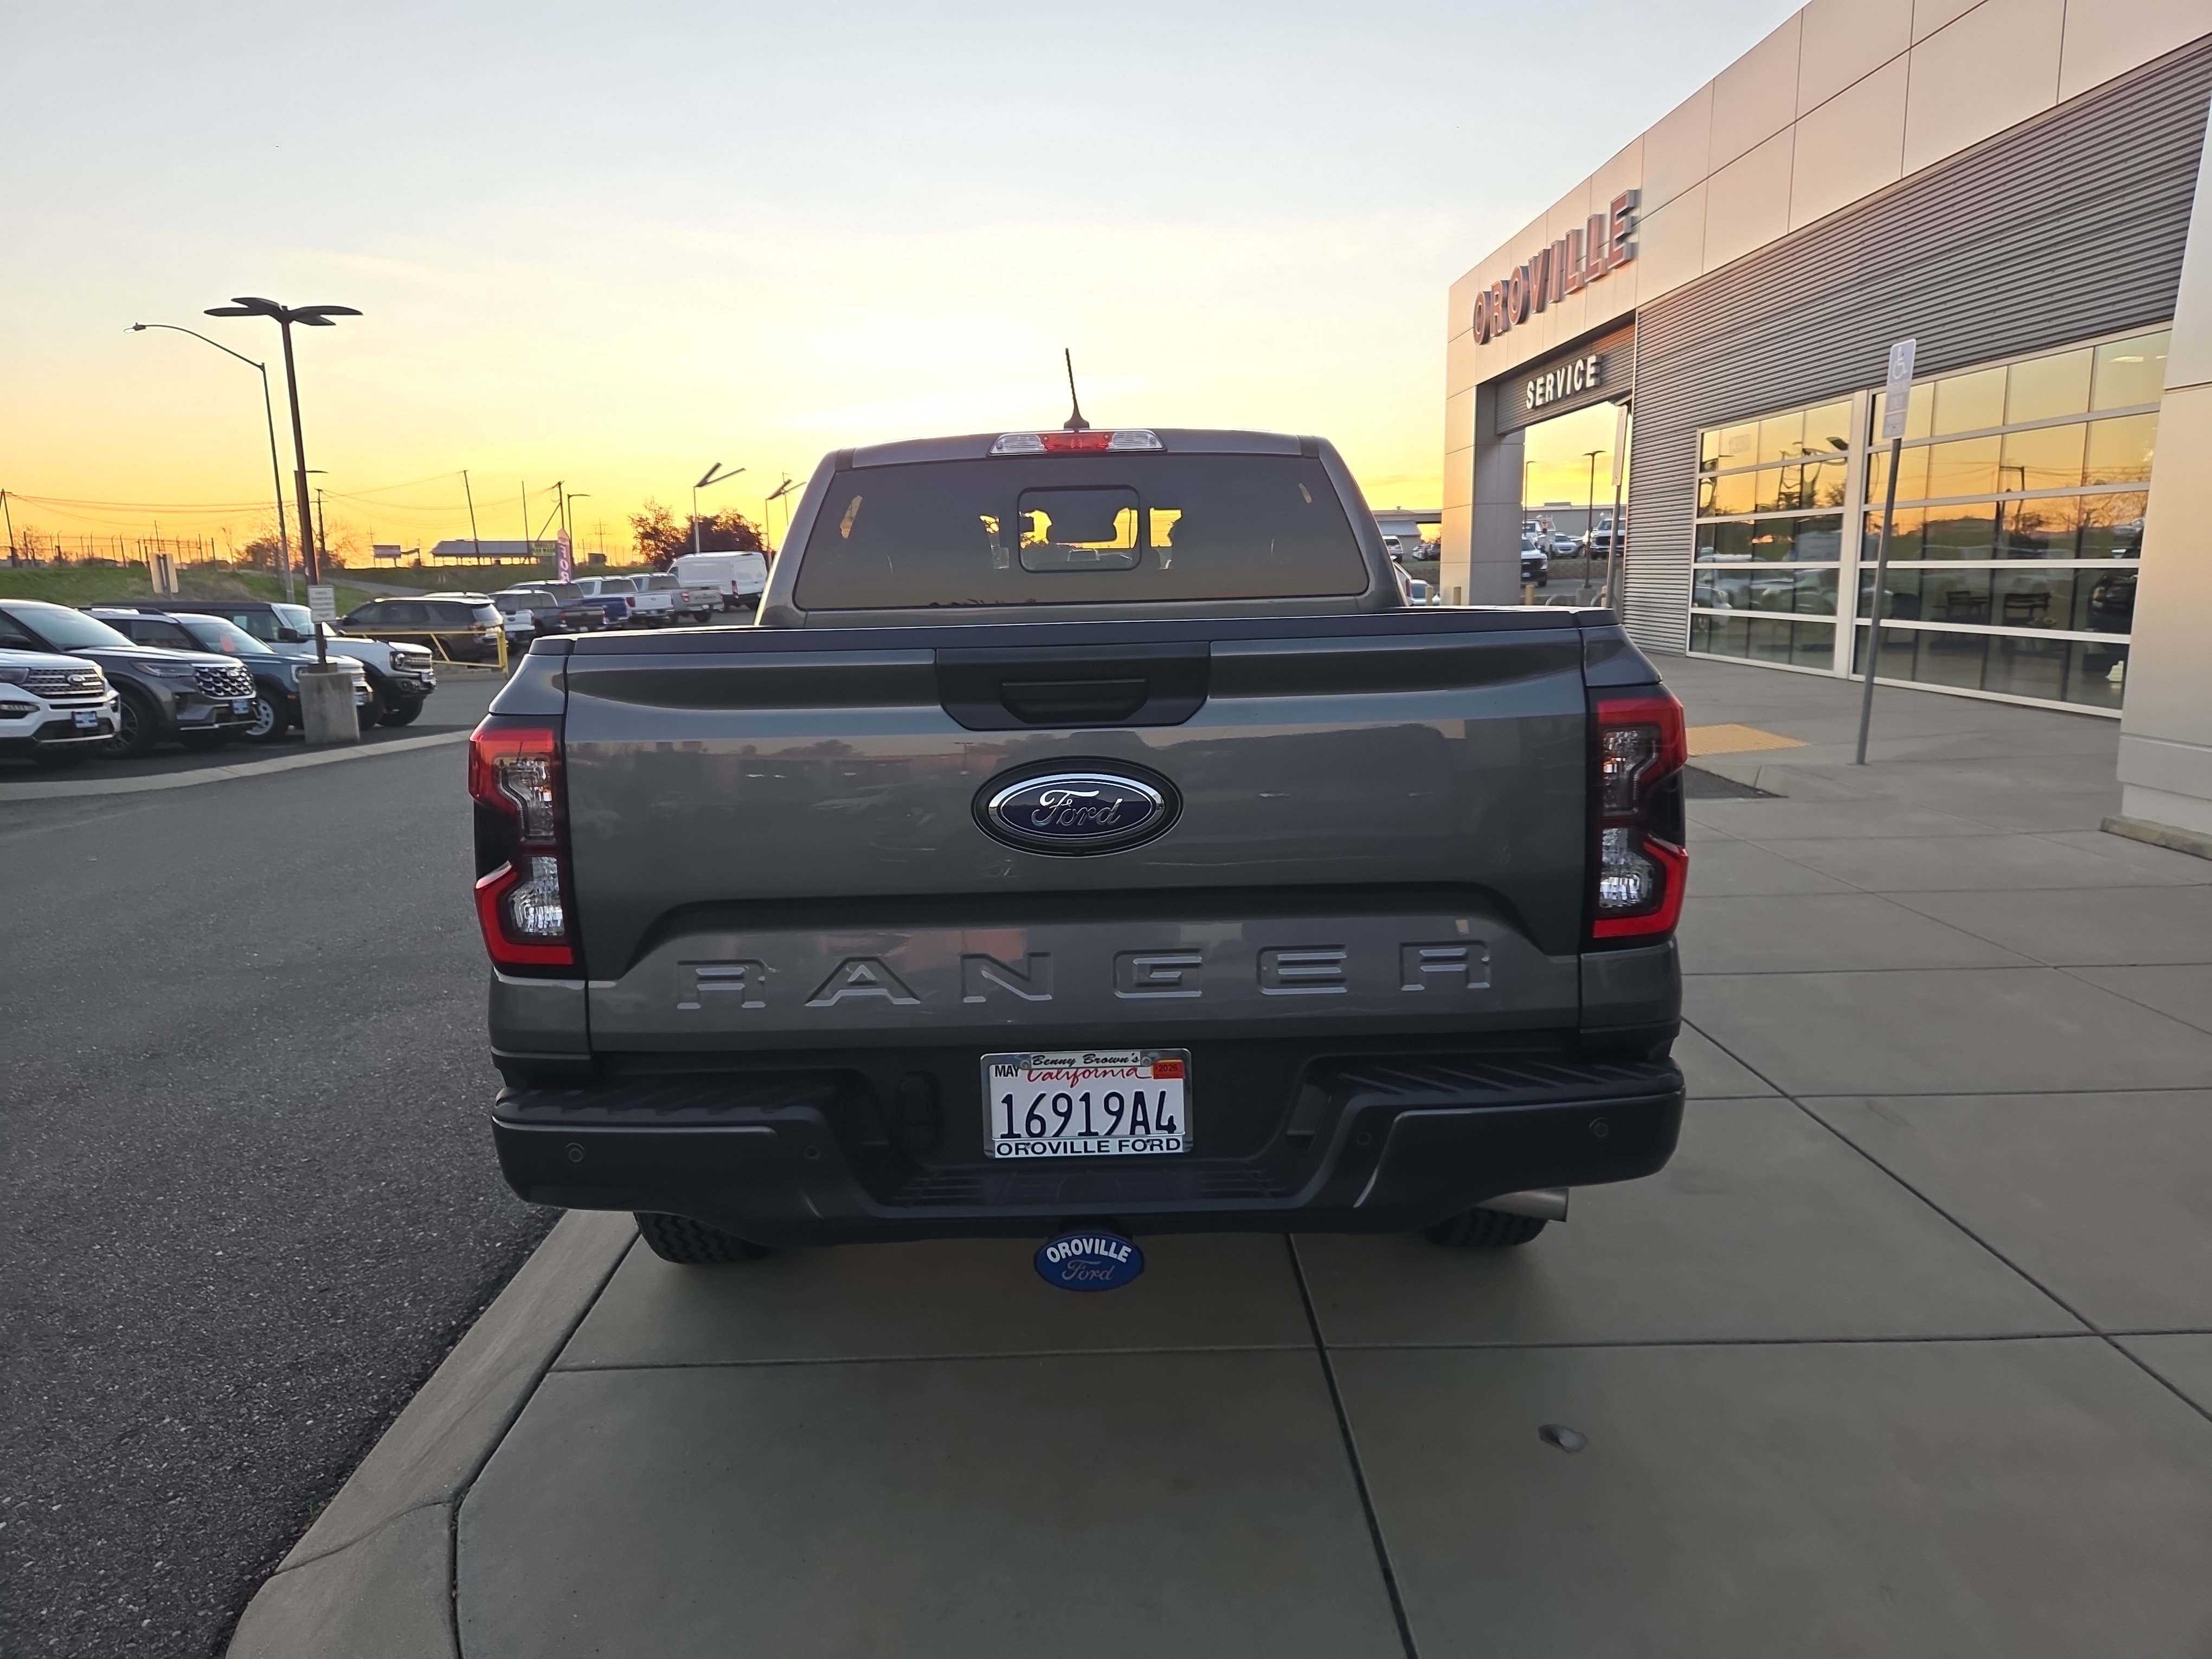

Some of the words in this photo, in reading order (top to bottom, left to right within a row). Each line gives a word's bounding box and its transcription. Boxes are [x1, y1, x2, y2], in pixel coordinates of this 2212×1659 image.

[1473, 189, 1641, 345] OROVILLE
[1526, 354, 1601, 410] SERVICE
[1031, 789, 1123, 827] Ford
[677, 939, 1491, 1009] RANGER
[994, 1065, 1020, 1078] MAY
[1032, 1054, 1076, 1068] Benny
[1082, 1052, 1139, 1065] Brown's
[1159, 1064, 1178, 1072] 2026
[1027, 1066, 1152, 1089] California
[1000, 1090, 1177, 1139] 16919A4
[996, 1139, 1110, 1156] OROVILLE
[1118, 1137, 1181, 1152] FORD
[1046, 1238, 1132, 1263] OROVILLE
[1062, 1259, 1115, 1281] Ford
